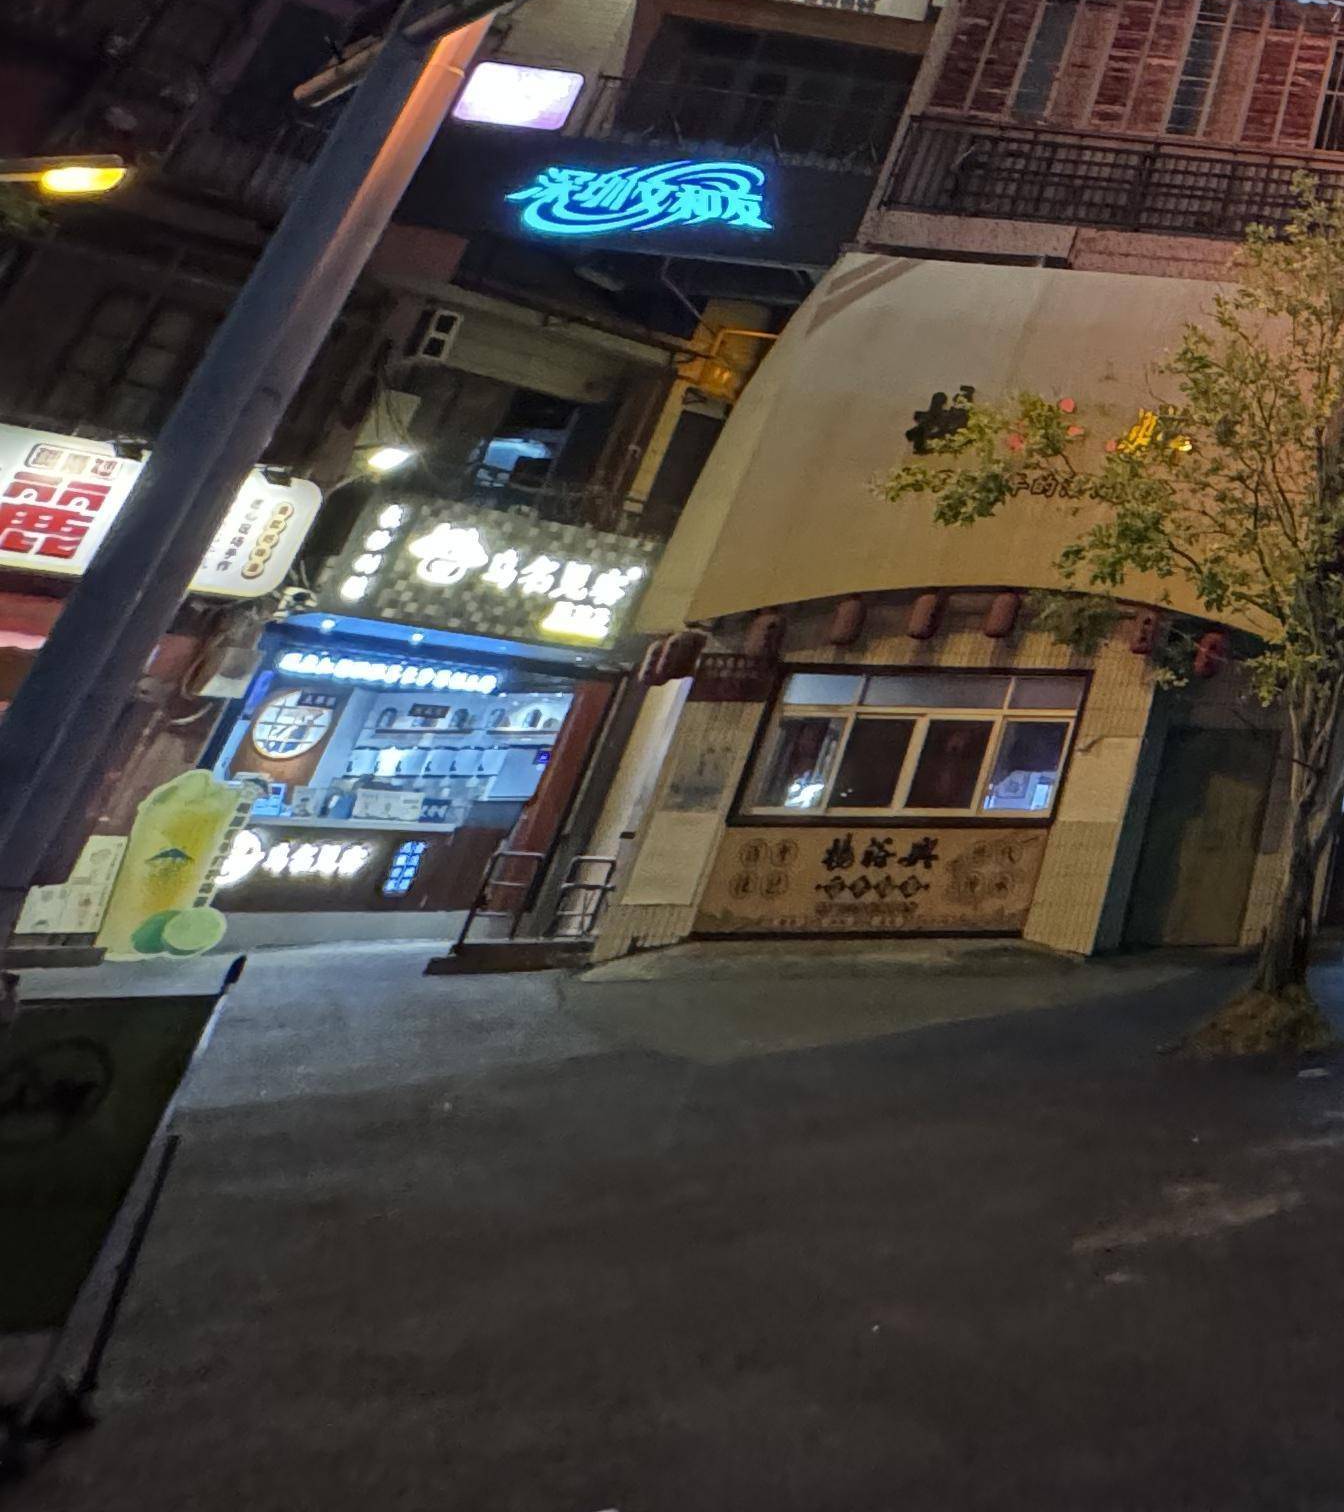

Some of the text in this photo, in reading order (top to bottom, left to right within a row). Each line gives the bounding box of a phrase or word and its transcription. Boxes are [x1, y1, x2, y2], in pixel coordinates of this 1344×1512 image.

[504, 159, 774, 234] 深圳文和友
